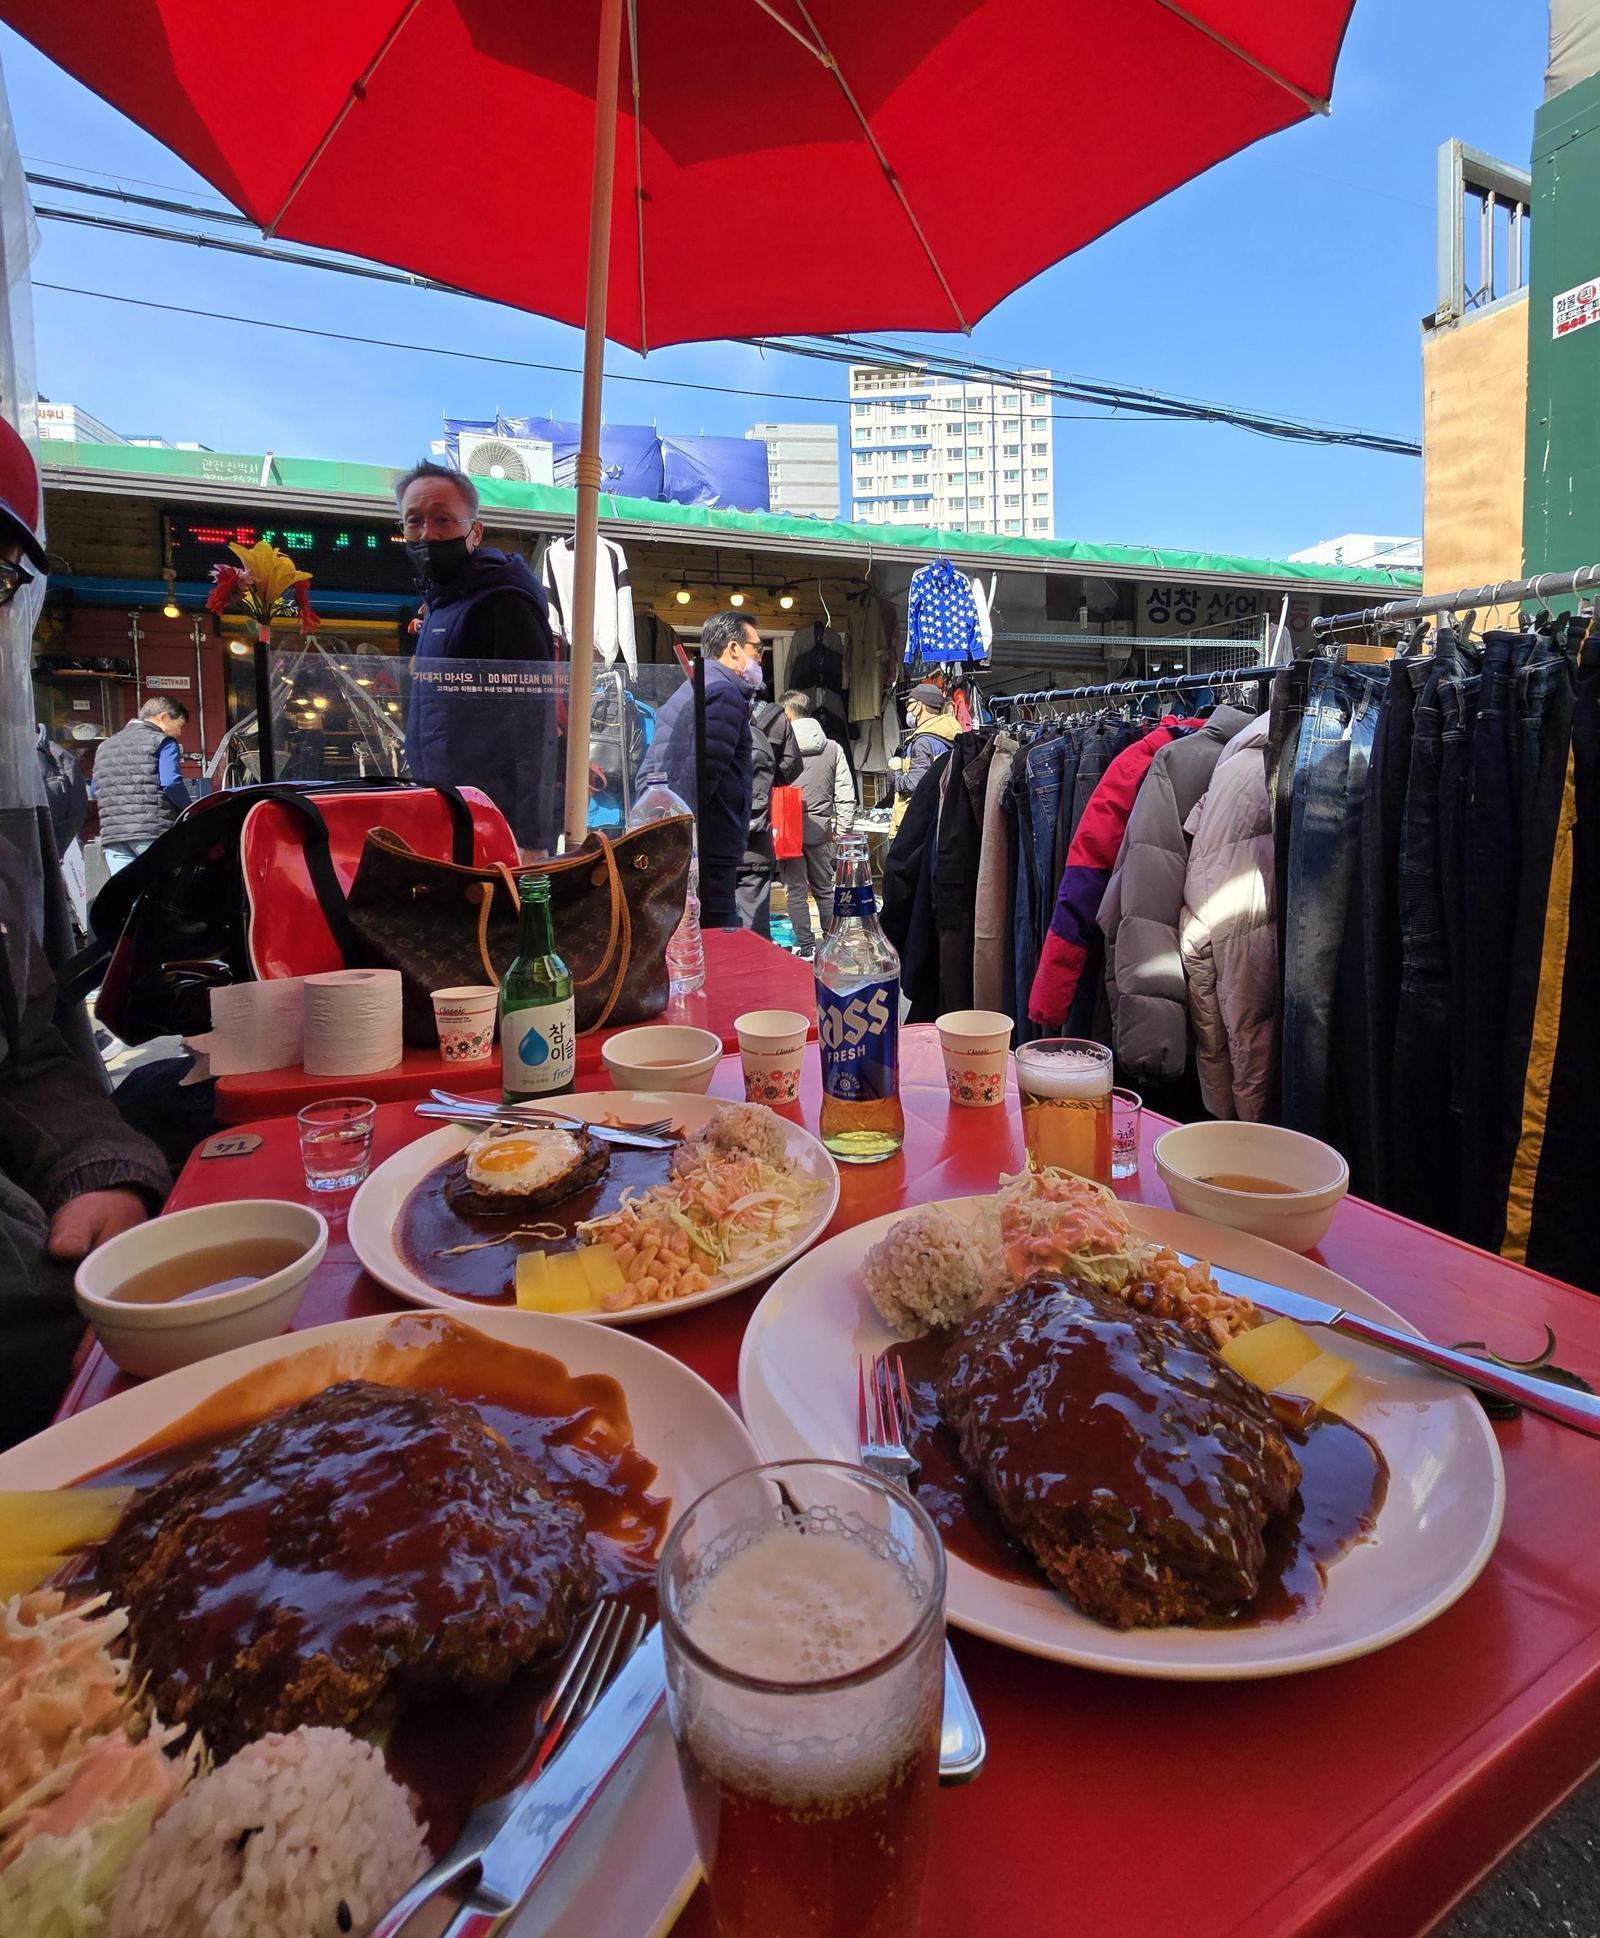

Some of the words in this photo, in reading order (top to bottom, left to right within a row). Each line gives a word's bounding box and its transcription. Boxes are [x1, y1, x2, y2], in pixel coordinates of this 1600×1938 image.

[1147, 587, 1200, 625] 성창
[444, 672, 474, 684] 마시오
[488, 673, 500, 684] DO
[501, 674, 518, 684] NOT
[519, 674, 540, 685] LEAN
[541, 674, 553, 685] ON
[554, 675, 569, 685] THE
[827, 1044, 867, 1064] FRESH
[552, 1066, 573, 1081] fresh
